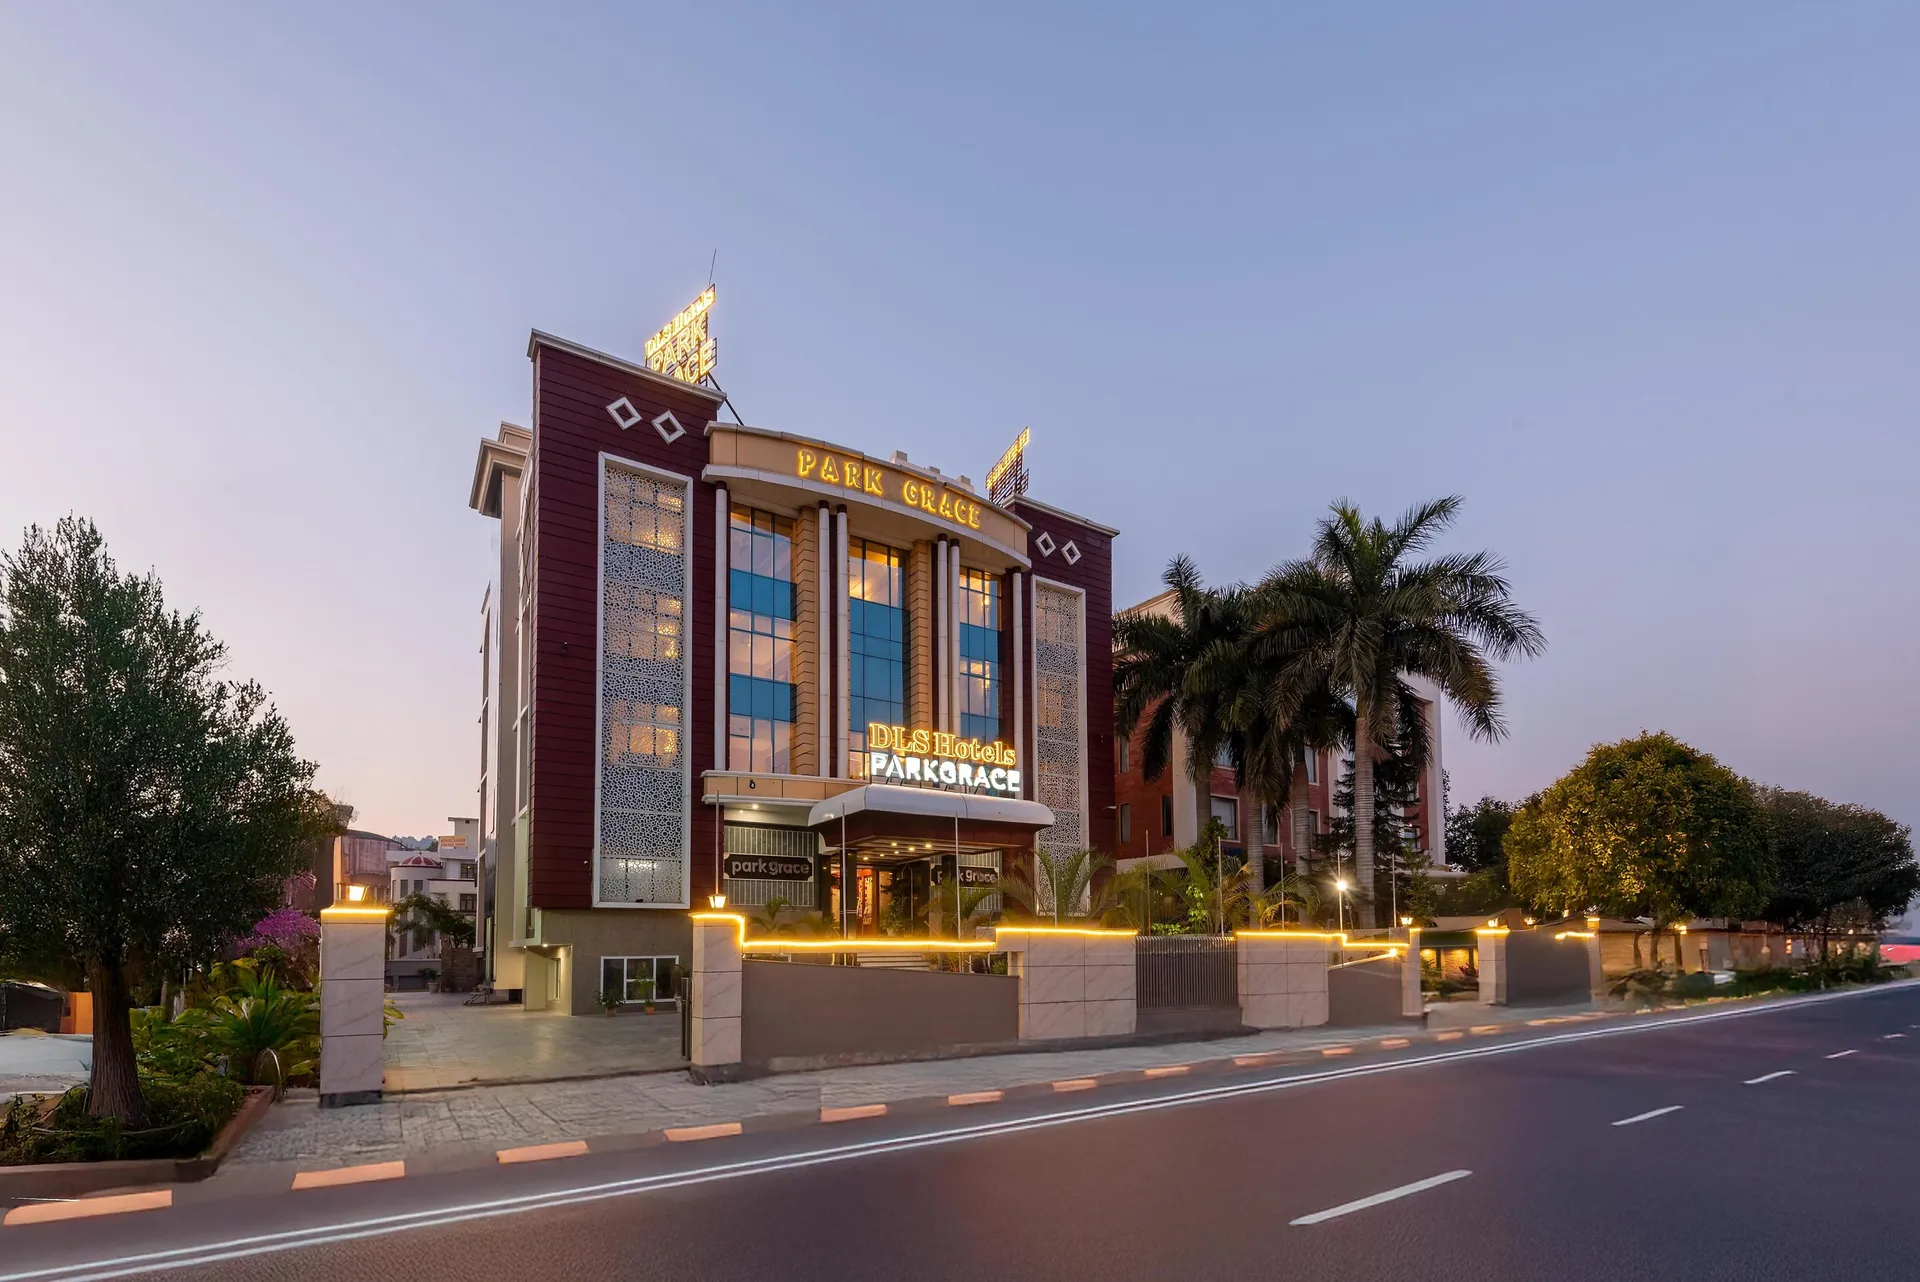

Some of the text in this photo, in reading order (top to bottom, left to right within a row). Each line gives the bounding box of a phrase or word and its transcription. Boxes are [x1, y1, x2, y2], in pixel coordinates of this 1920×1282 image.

[651, 311, 706, 373] PARK
[798, 449, 981, 529] PARK GRACE
[868, 722, 1016, 766] DLS Hotels
